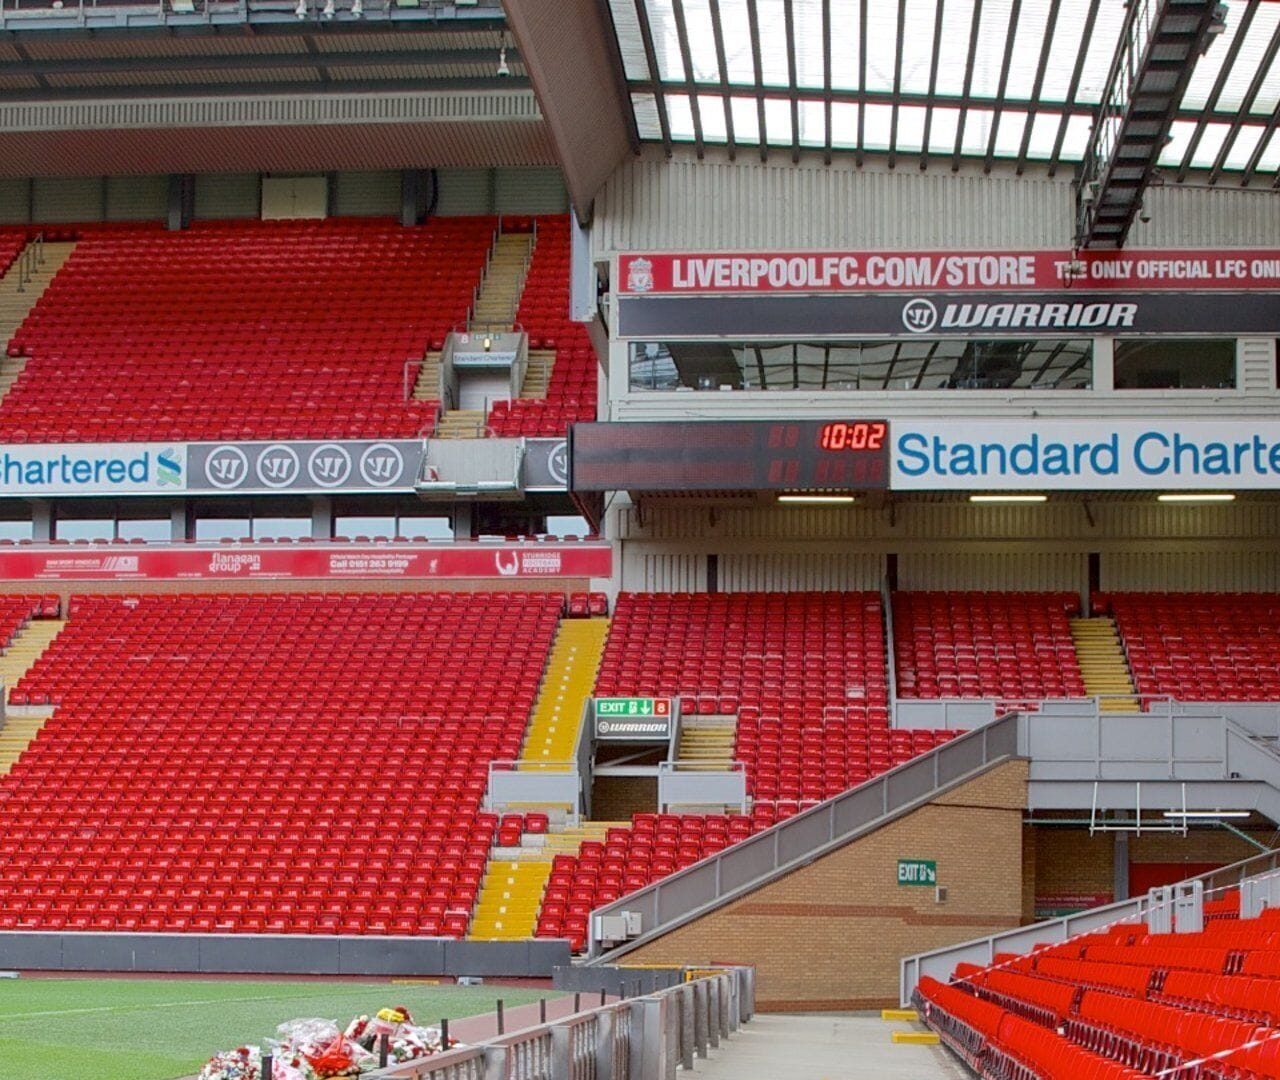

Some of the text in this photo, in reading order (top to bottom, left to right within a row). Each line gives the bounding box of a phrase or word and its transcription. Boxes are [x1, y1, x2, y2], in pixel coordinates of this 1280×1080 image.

[672, 255, 1035, 289] LIVERPOOLFC.COM/STORE
[1091, 260, 1133, 279] ONLY
[1136, 260, 1212, 279] OFFICIAL
[1215, 260, 1247, 279] LFC
[940, 303, 1139, 328] WARRIOR
[821, 422, 887, 451] 10:02
[898, 433, 1119, 477] Standard
[209, 561, 243, 573] group
[211, 552, 261, 567] flanagan
[600, 702, 666, 713] EXIT 8
[610, 723, 668, 732] WARRIOR
[898, 863, 919, 881] EXIT
